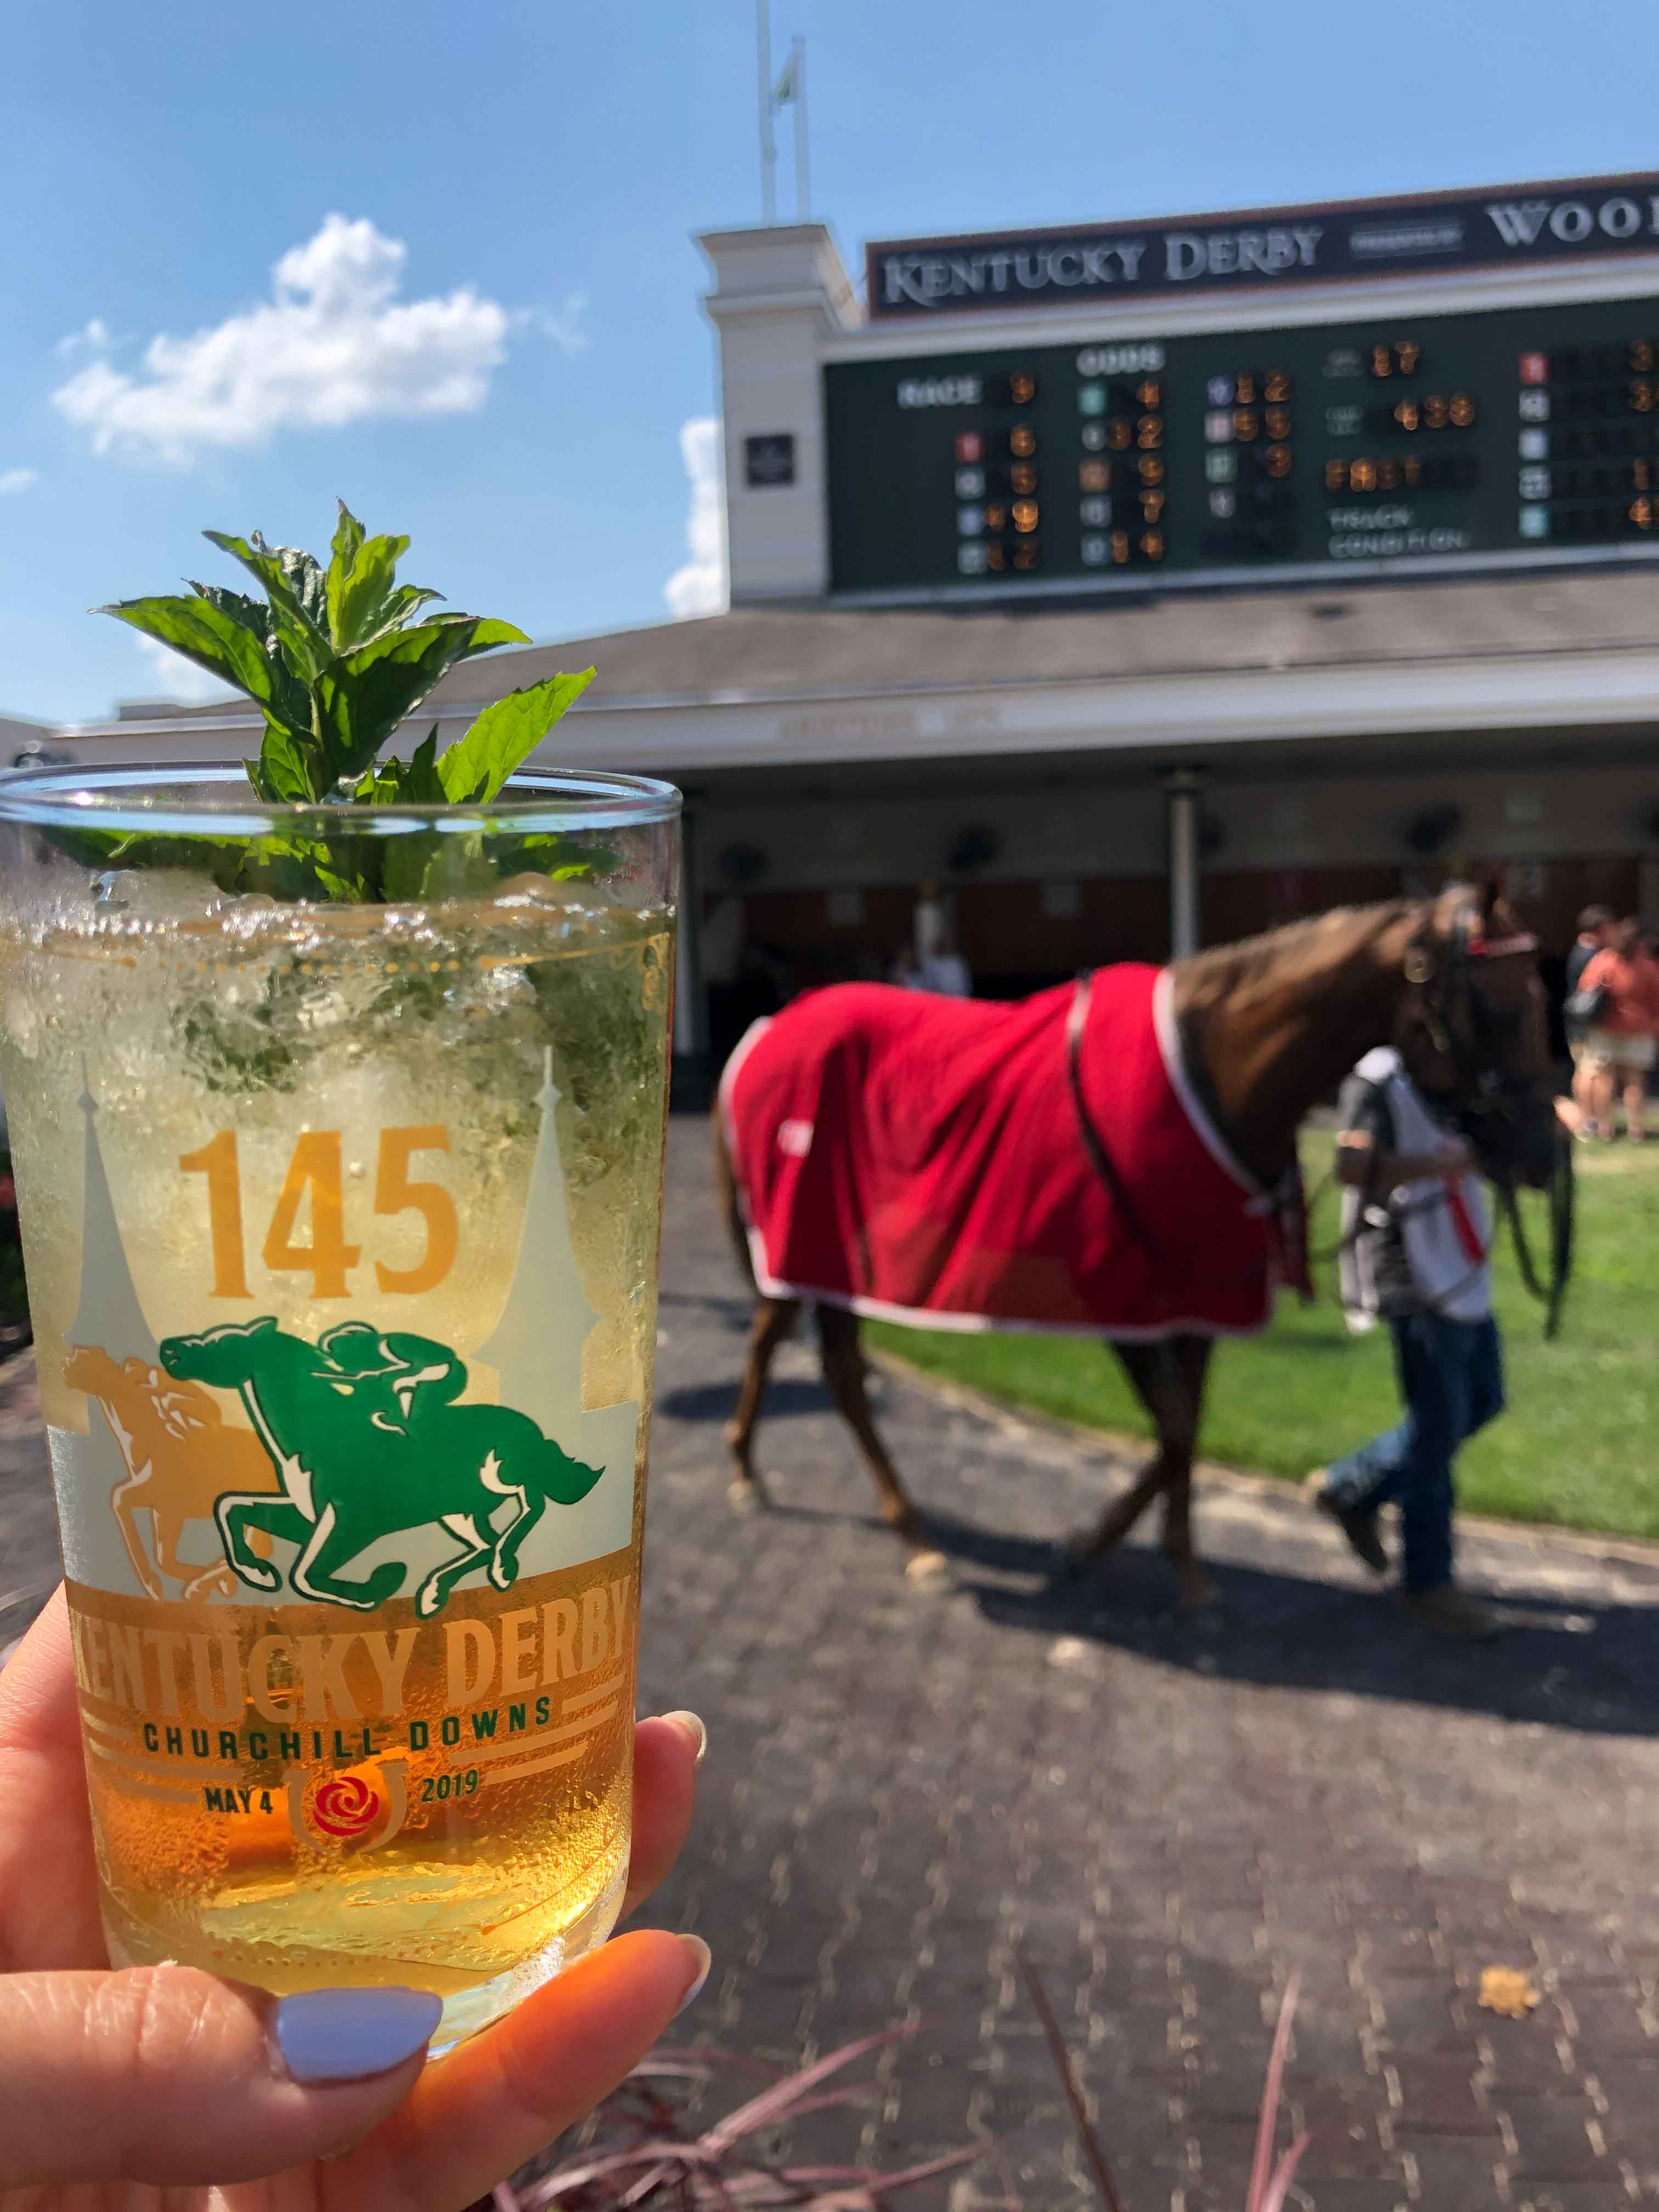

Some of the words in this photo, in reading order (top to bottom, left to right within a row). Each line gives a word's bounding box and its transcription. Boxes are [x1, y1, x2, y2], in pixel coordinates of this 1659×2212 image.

[883, 237, 1147, 307] KENTUCKY
[1162, 224, 1324, 281] DERBY
[896, 374, 984, 409] RACE
[179, 1124, 459, 1299] 145
[443, 1576, 631, 1707] DERBY
[144, 1723, 380, 1760] CHURCHILL
[409, 1696, 551, 1751] DOWNS
[204, 1786, 252, 1813] MAY
[259, 1789, 273, 1815] 4
[421, 1769, 479, 1803] 2019
